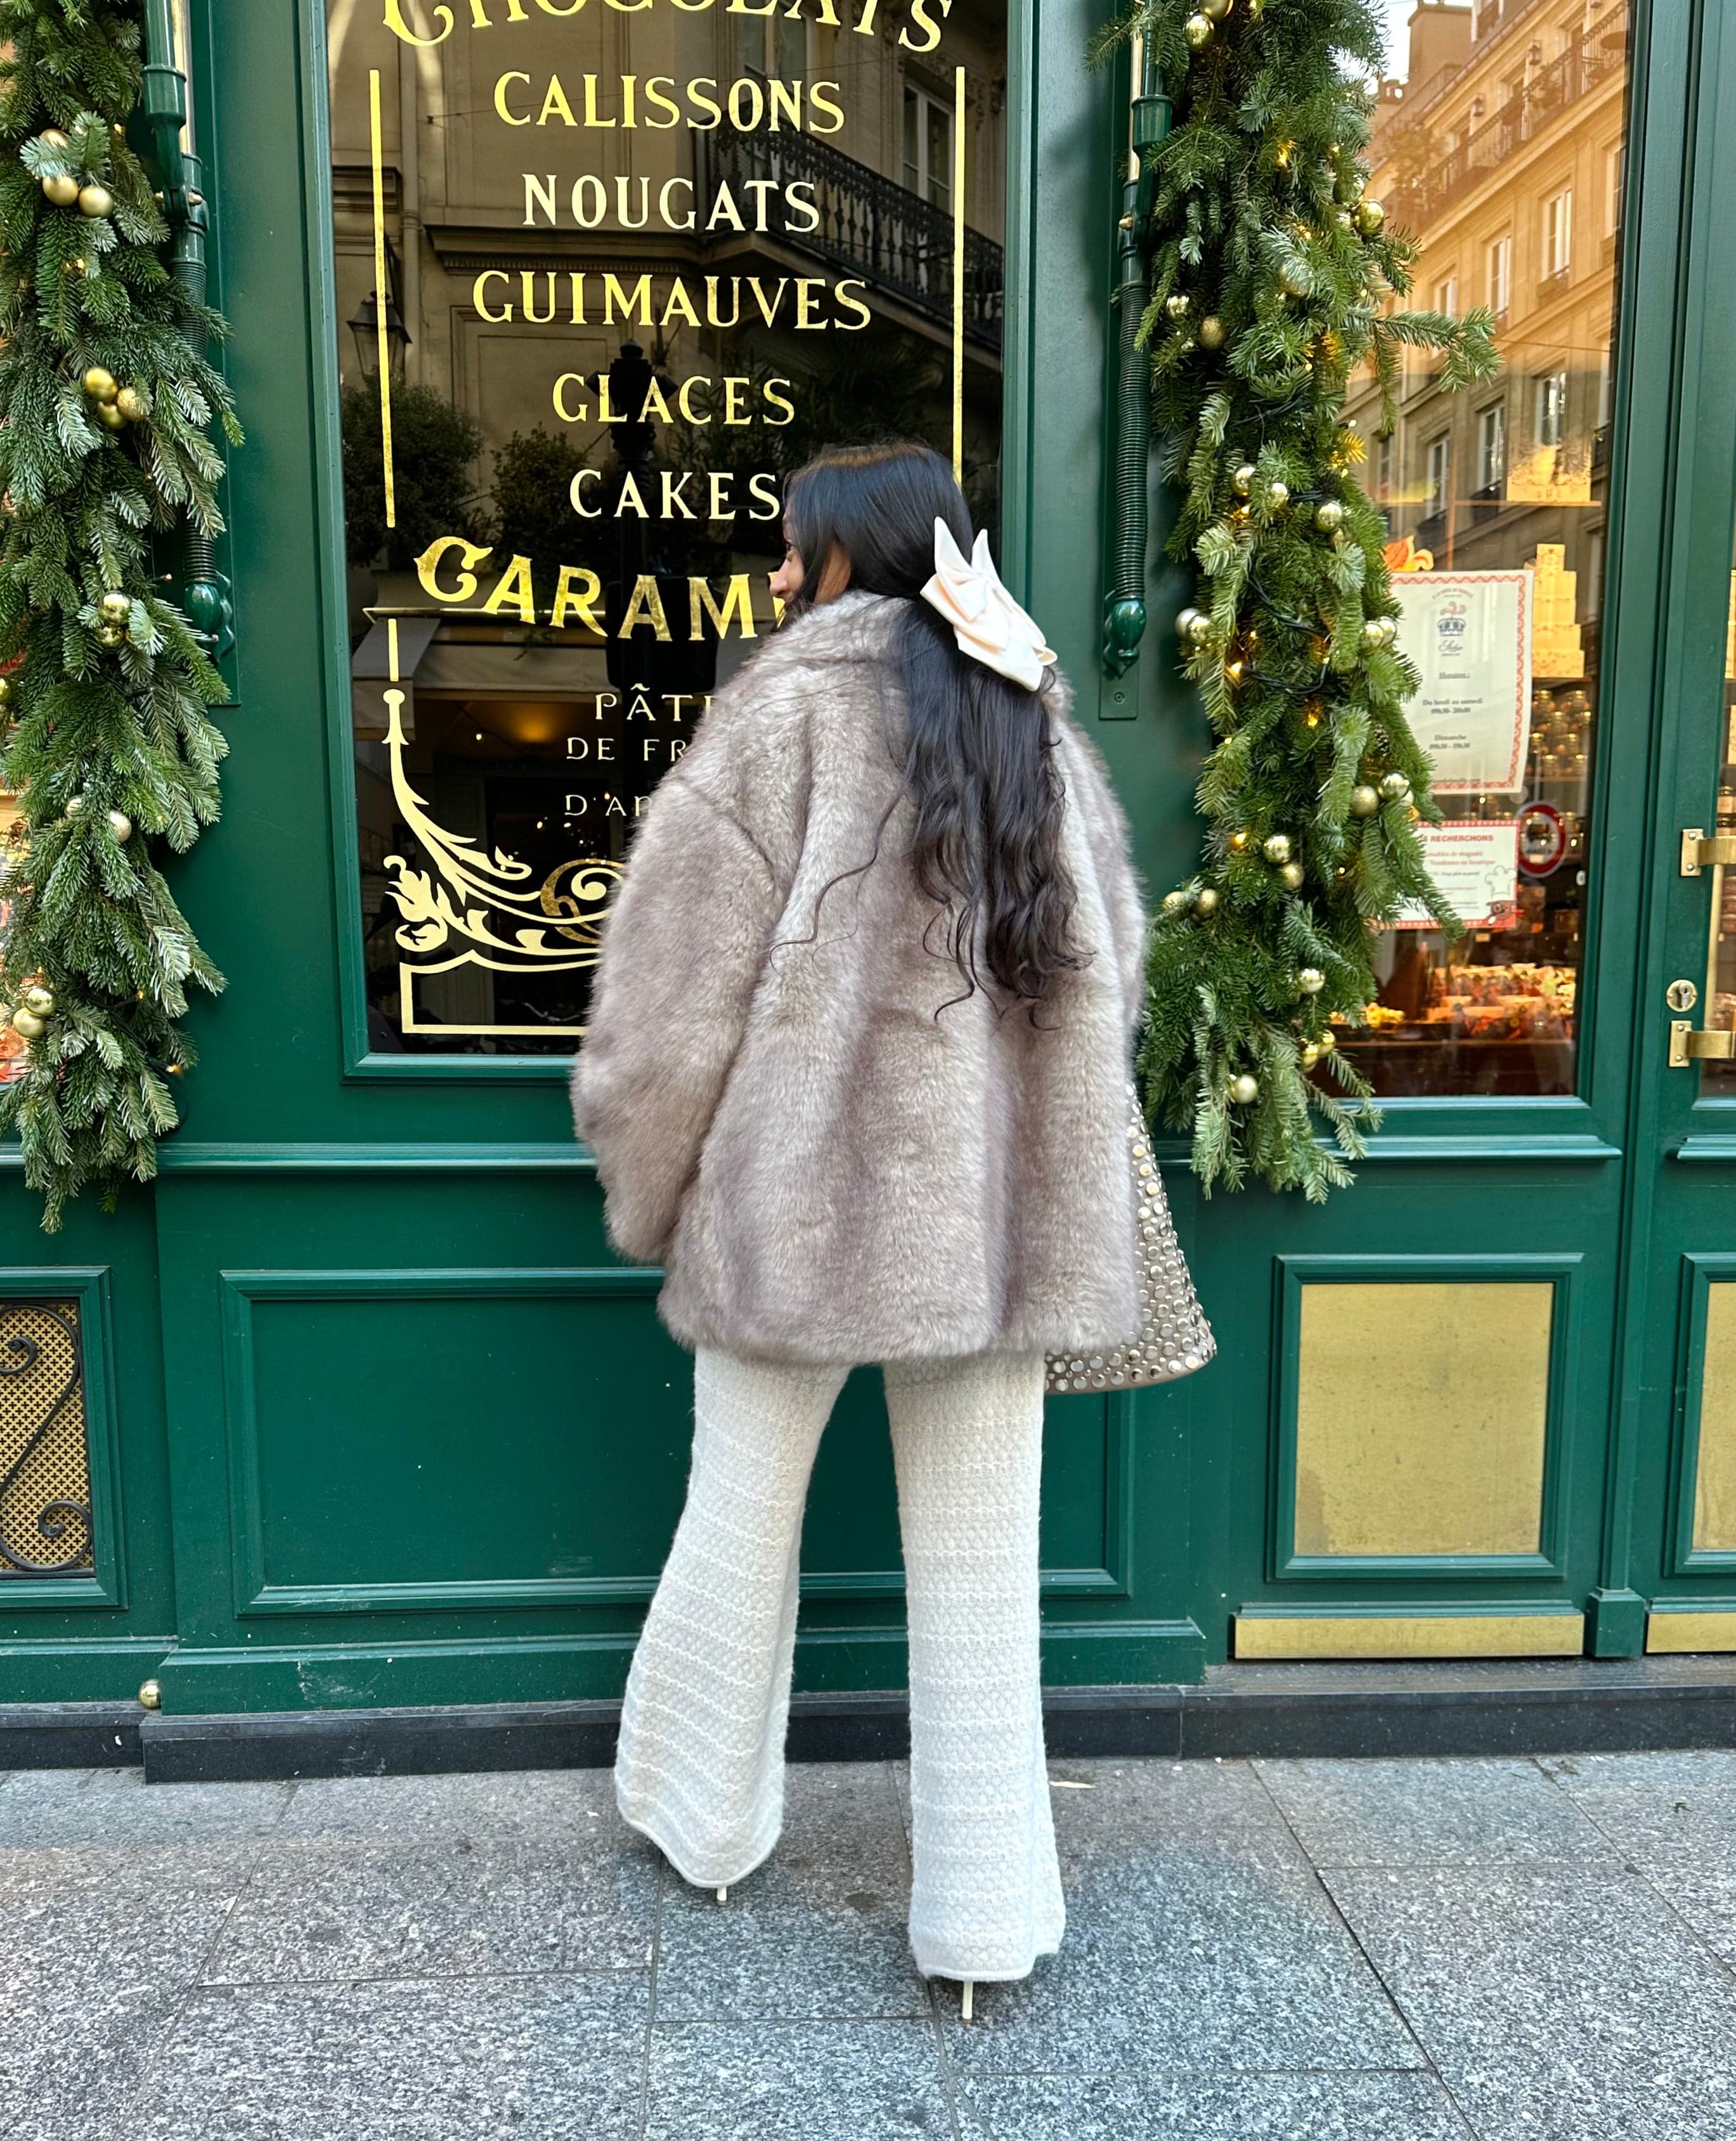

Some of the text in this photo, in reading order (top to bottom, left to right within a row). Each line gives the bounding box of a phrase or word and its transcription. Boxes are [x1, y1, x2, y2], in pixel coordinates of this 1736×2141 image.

[493, 70, 845, 134] CALISSONS
[521, 174, 820, 233] NOUGATS
[472, 269, 871, 331] GUIMAUVES
[552, 373, 795, 425] GLACES
[569, 469, 782, 520] CAKES
[413, 536, 787, 642] CARAM
[566, 737, 687, 761] DE FR
